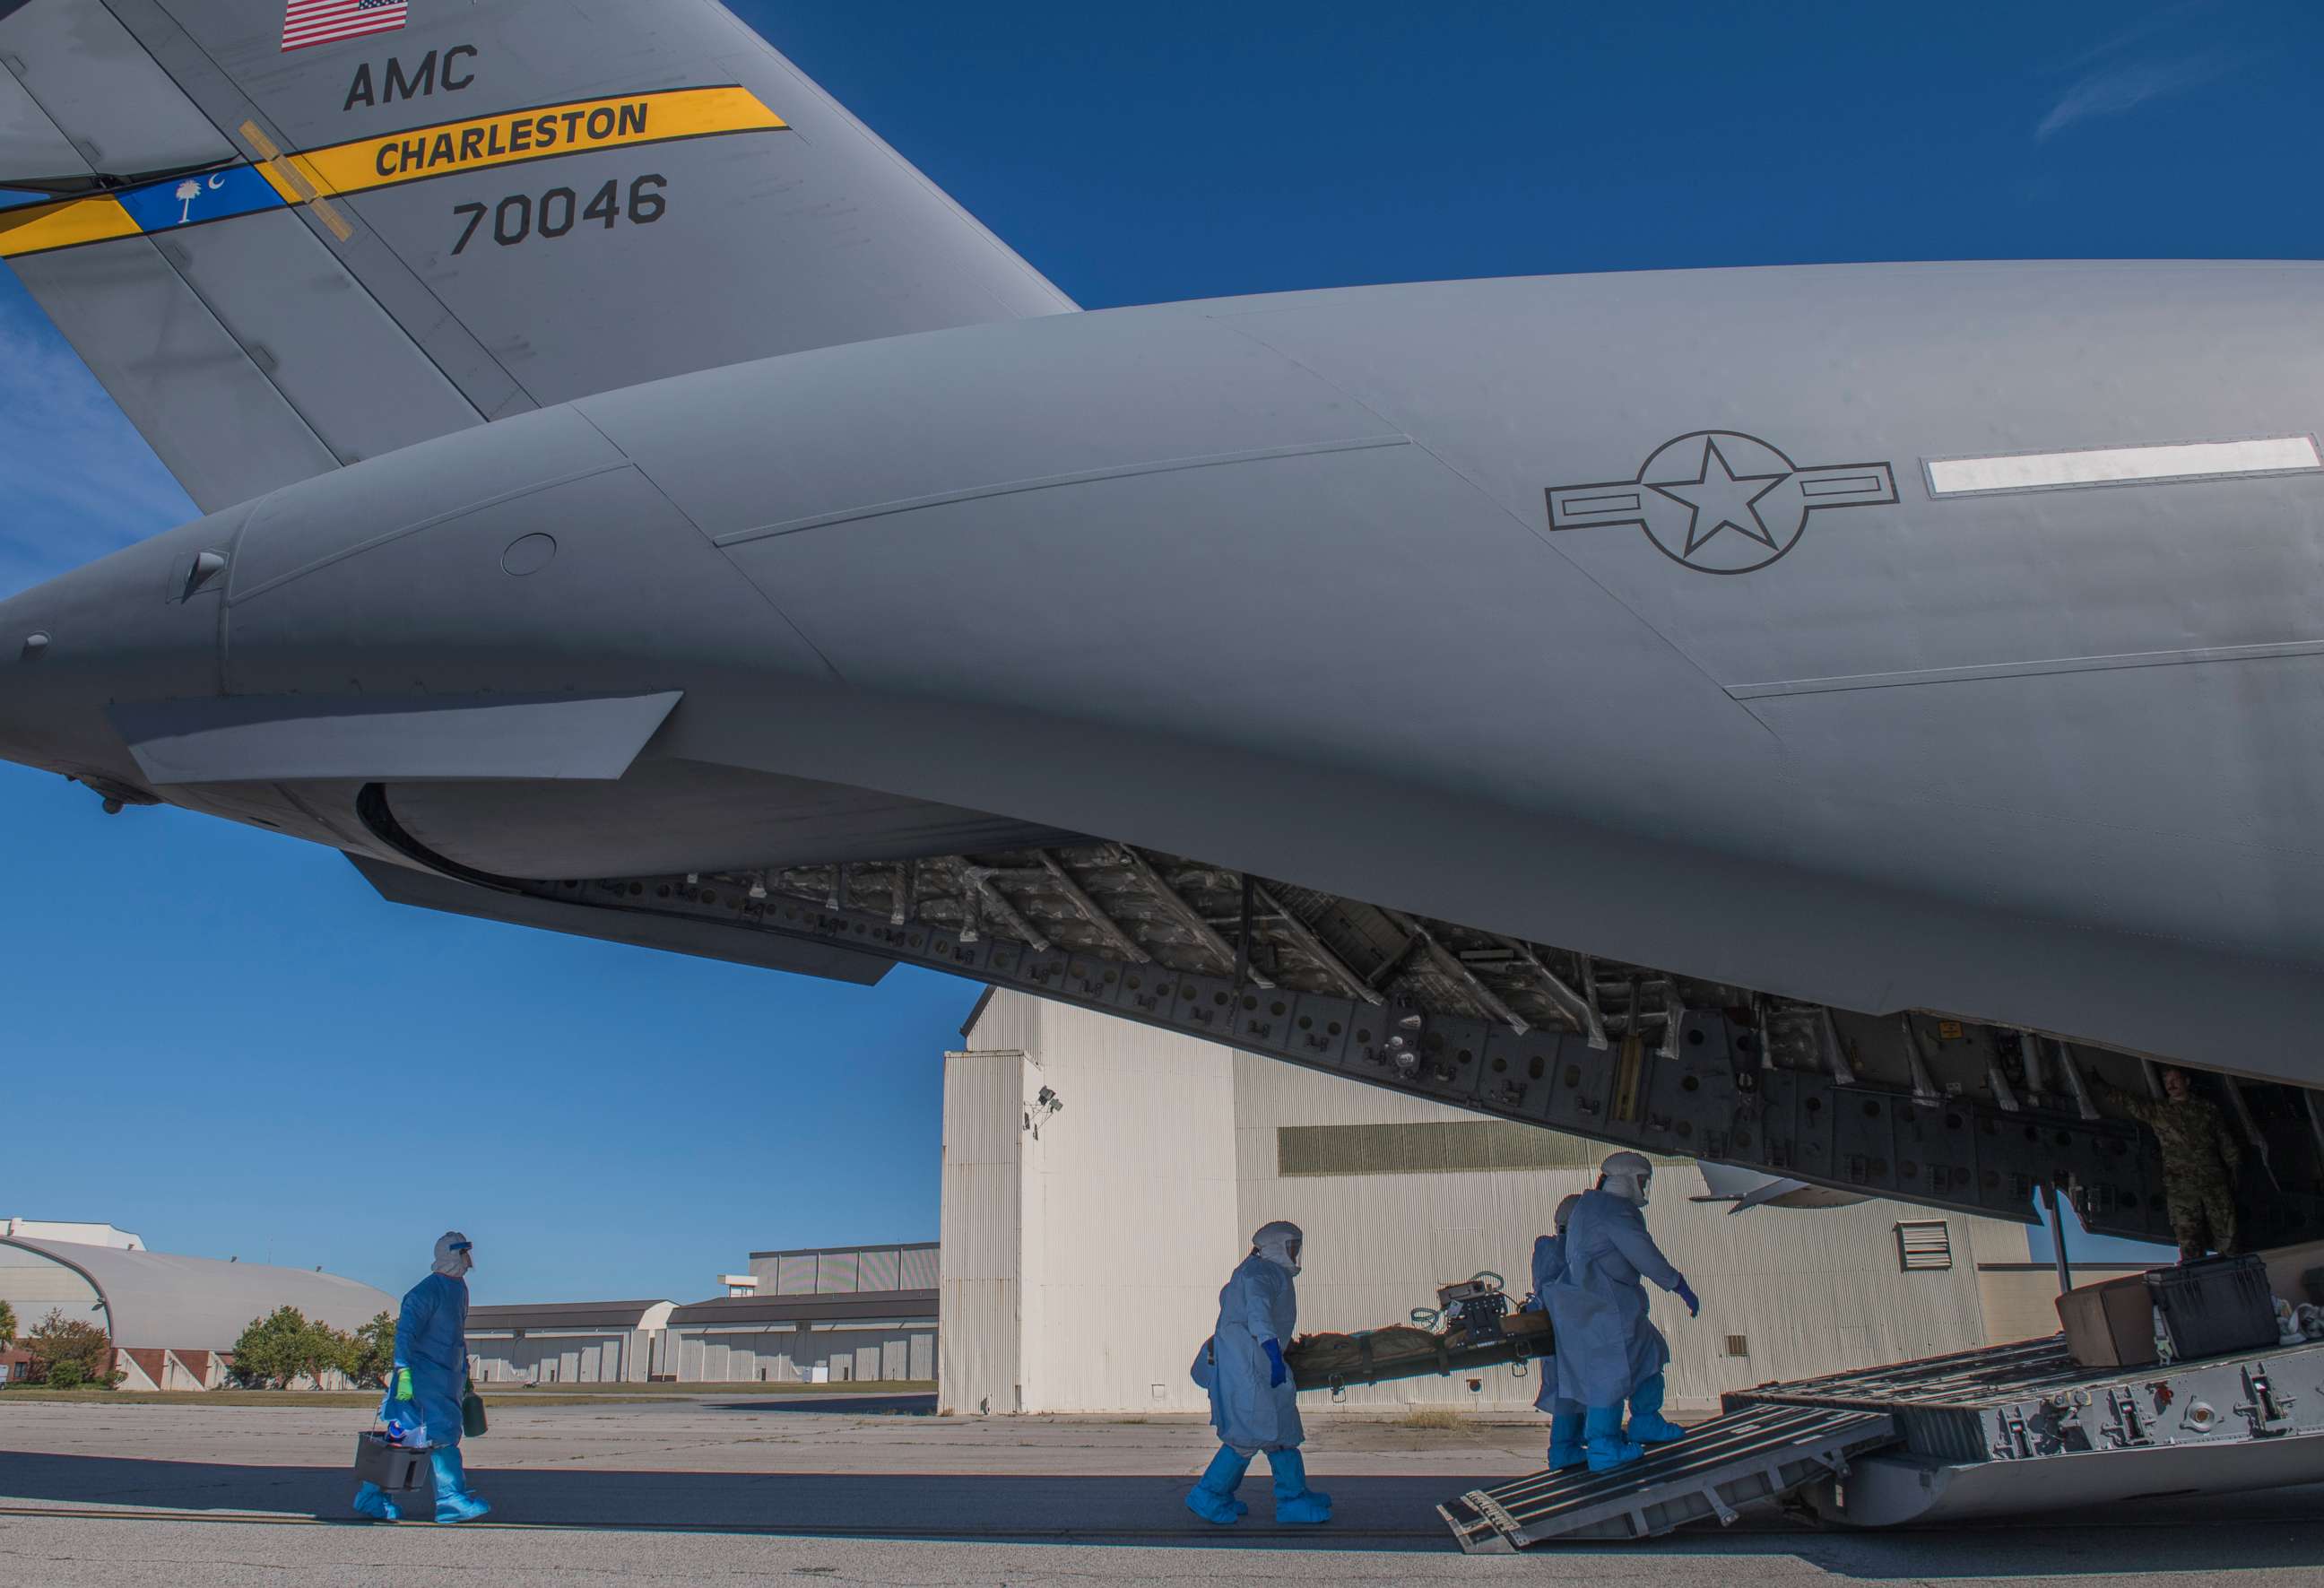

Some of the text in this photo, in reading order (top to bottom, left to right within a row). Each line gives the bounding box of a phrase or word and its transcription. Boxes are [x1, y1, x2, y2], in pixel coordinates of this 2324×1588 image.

[344, 45, 478, 111] AMC
[376, 104, 648, 177] CHARLESTON
[451, 175, 667, 256] 70046
